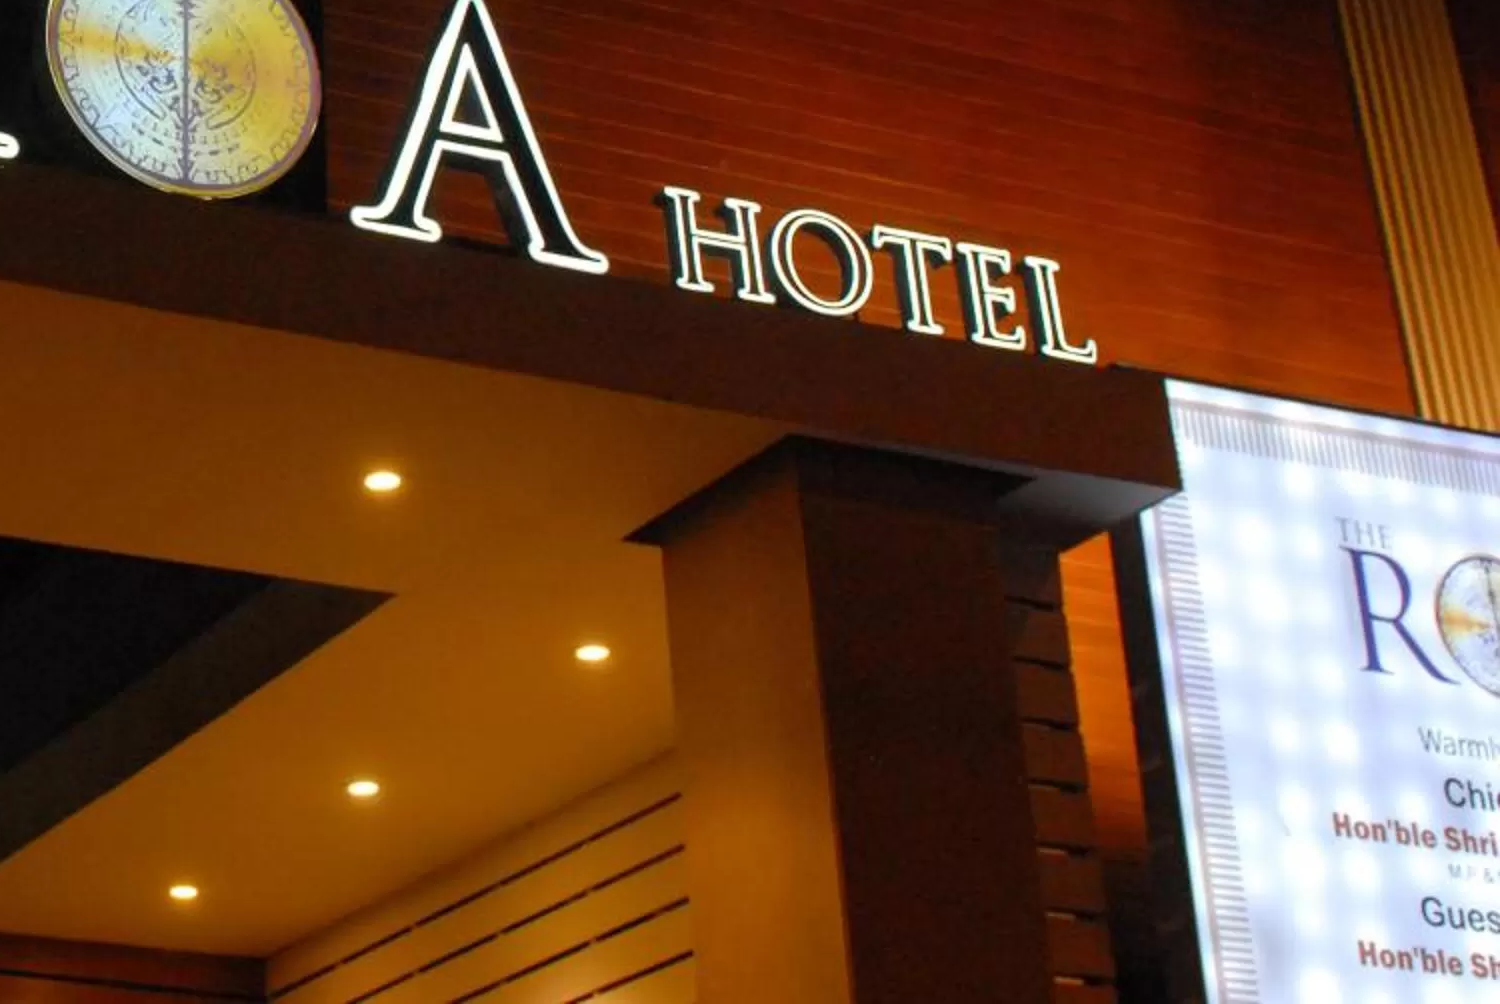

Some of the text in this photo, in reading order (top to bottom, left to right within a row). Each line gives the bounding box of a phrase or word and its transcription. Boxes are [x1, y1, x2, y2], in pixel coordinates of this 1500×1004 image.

[663, 185, 1097, 364] HOTEL
[1335, 515, 1393, 549] THE
[1443, 776, 1500, 812] Chi
[1332, 811, 1500, 857] Hon'ble Shri
[1357, 939, 1464, 976] Hon'ble
